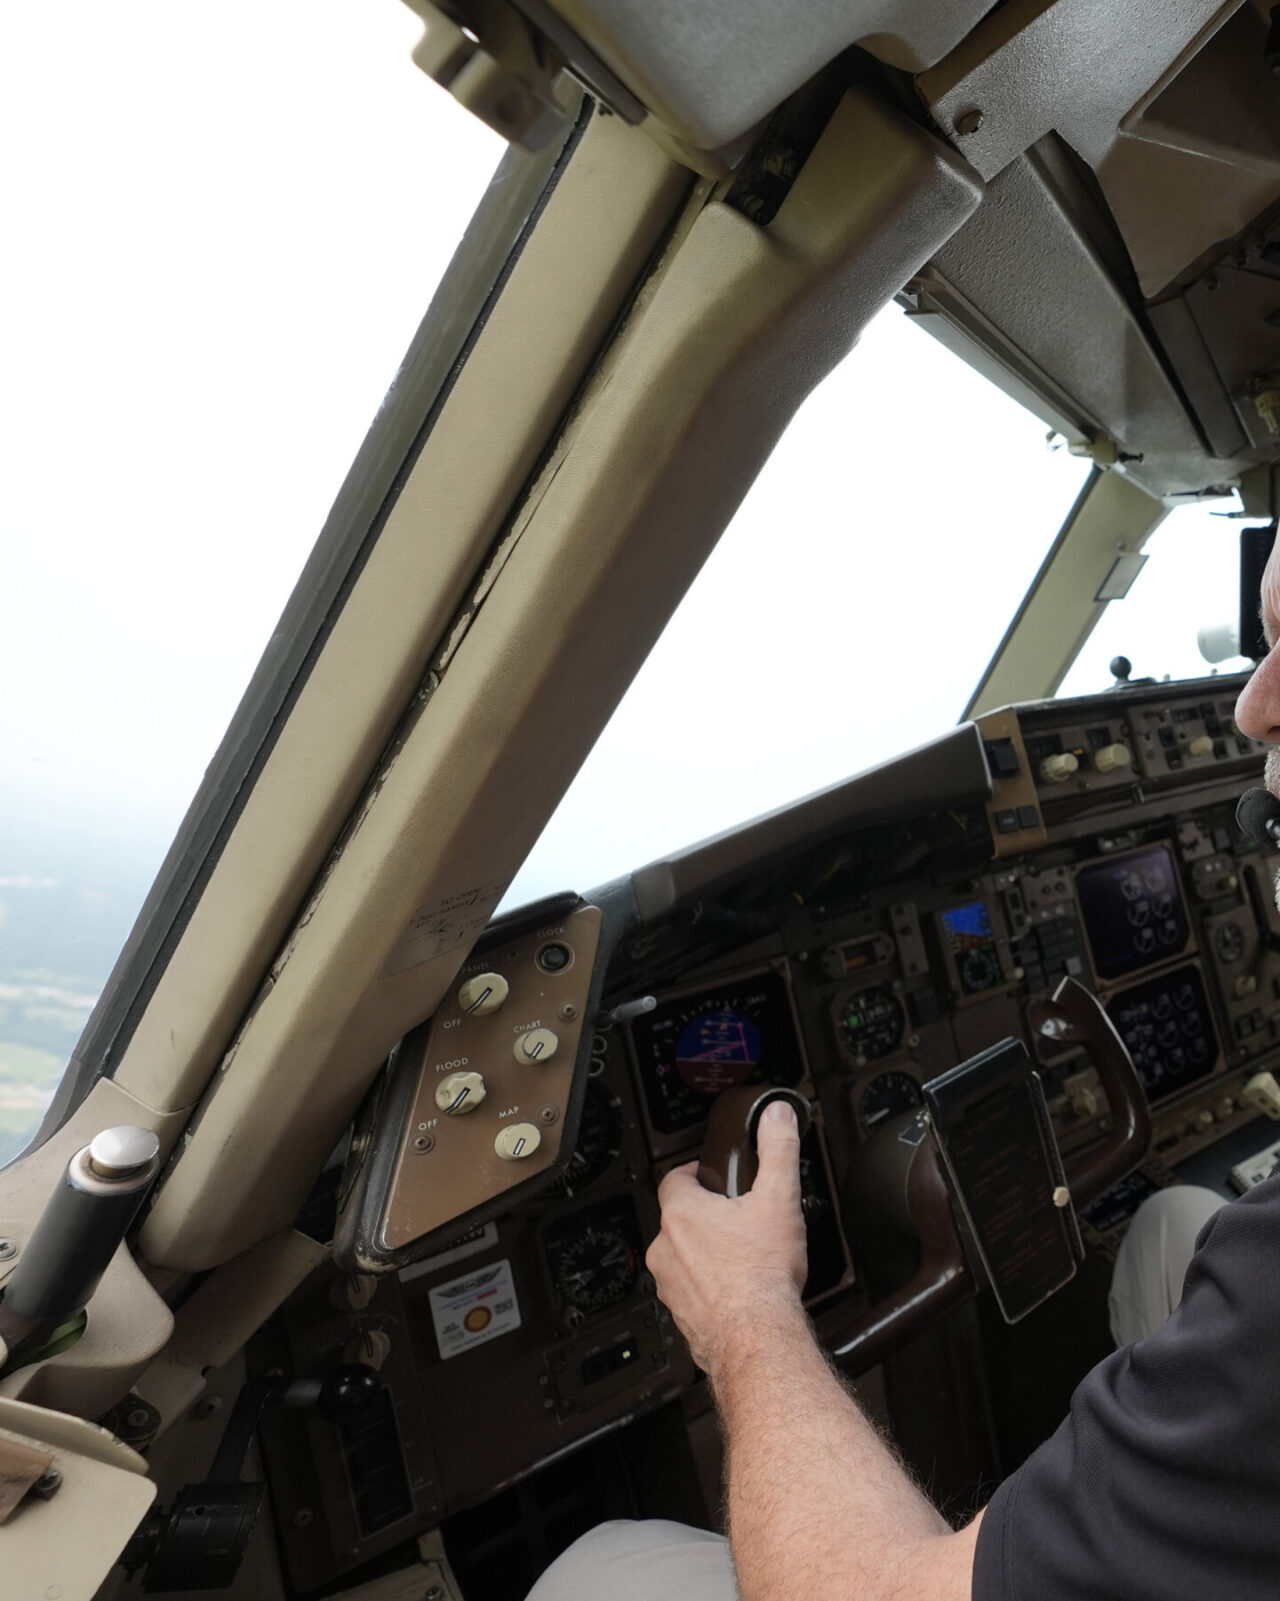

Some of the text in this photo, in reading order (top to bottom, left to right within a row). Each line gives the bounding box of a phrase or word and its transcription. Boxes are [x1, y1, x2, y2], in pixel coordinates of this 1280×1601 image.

[536, 926, 566, 938] CLOCK
[461, 961, 491, 973] PANEL
[443, 1019, 461, 1029] OFF
[513, 1020, 542, 1033] CHART
[435, 1057, 469, 1072] FLOOD
[499, 1105, 520, 1119] MAP
[418, 1119, 438, 1131] OFF
